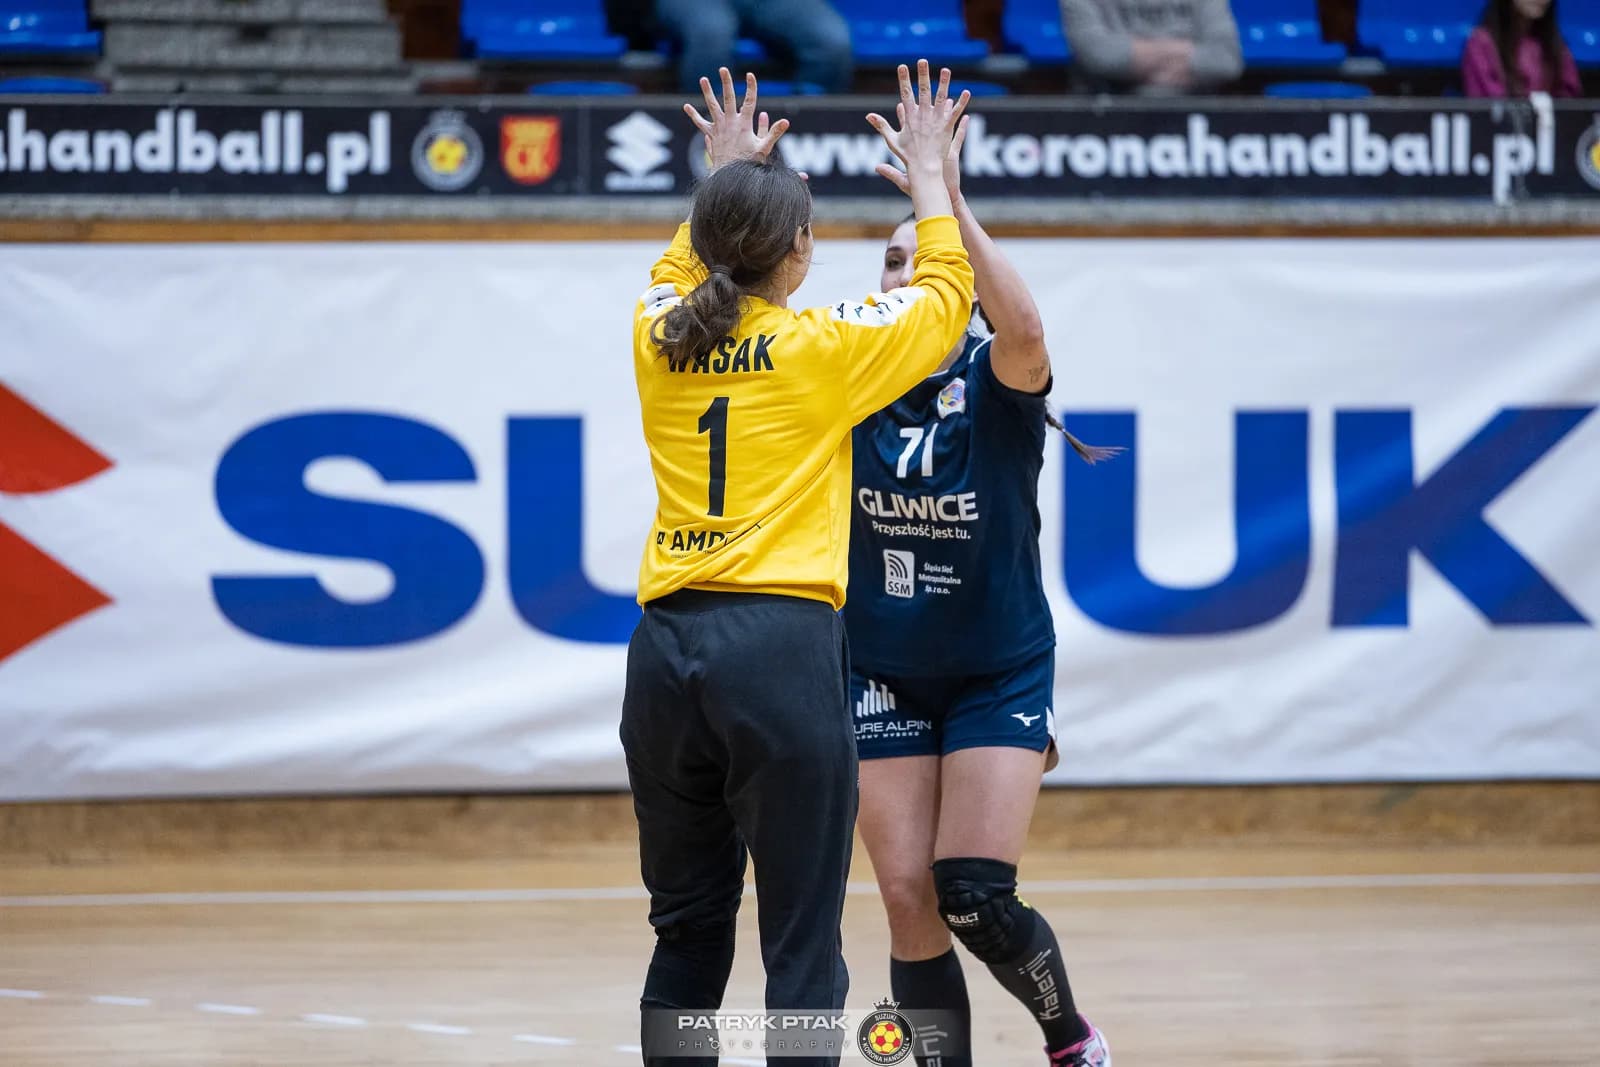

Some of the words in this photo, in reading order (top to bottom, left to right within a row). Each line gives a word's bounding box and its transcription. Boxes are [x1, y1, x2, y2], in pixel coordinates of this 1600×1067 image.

[0, 109, 391, 193] handball.pl
[777, 111, 1555, 203] wwkoronahandball.pl
[698, 396, 730, 517] 1
[896, 422, 939, 478] 71
[858, 487, 979, 521] GLIWICE
[210, 405, 1599, 650] SUUK
[872, 520, 931, 536] Przyszłość
[931, 526, 955, 539] jest
[955, 527, 971, 539] tu.
[888, 581, 911, 596] SSM
[853, 721, 884, 734] URE
[947, 912, 979, 924] SELECT
